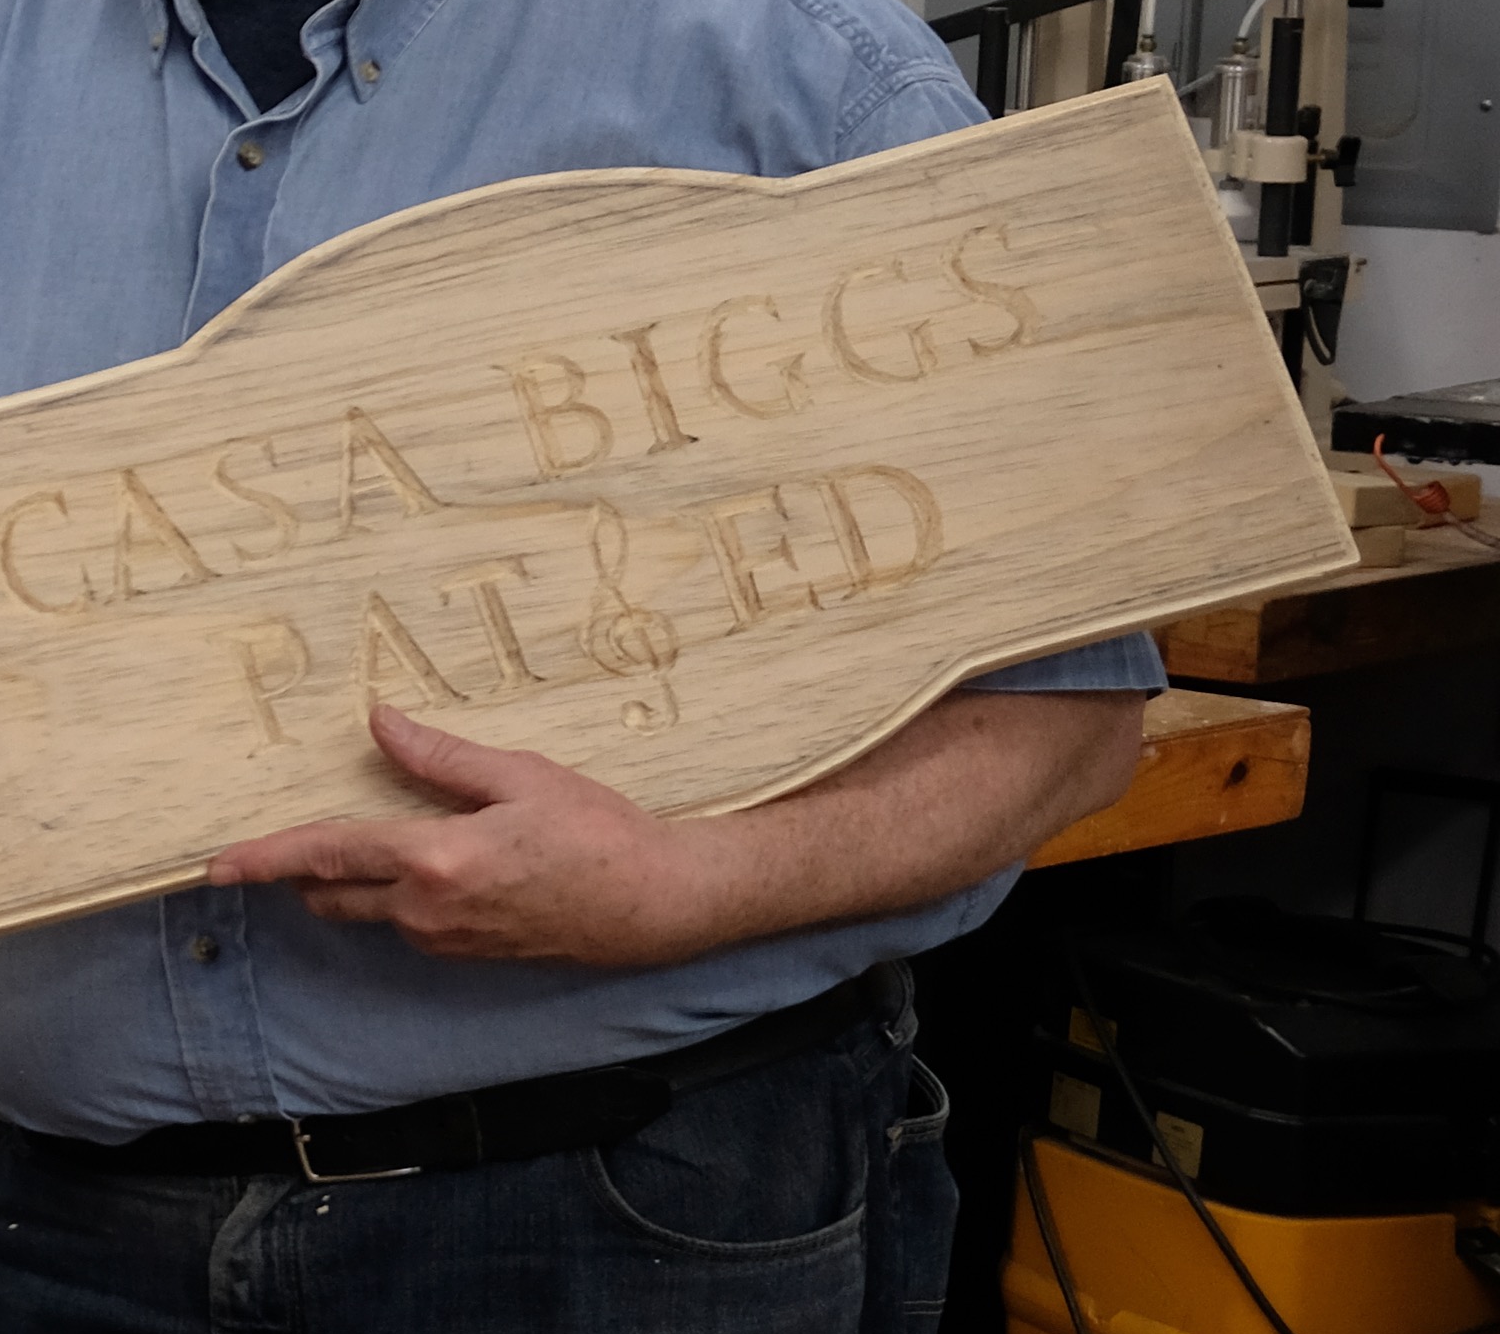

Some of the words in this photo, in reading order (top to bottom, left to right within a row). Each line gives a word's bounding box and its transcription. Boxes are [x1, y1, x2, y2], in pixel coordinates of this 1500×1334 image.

[491, 223, 1048, 484] BIGGS
[205, 554, 546, 760] PAT
[704, 464, 946, 638] ED
